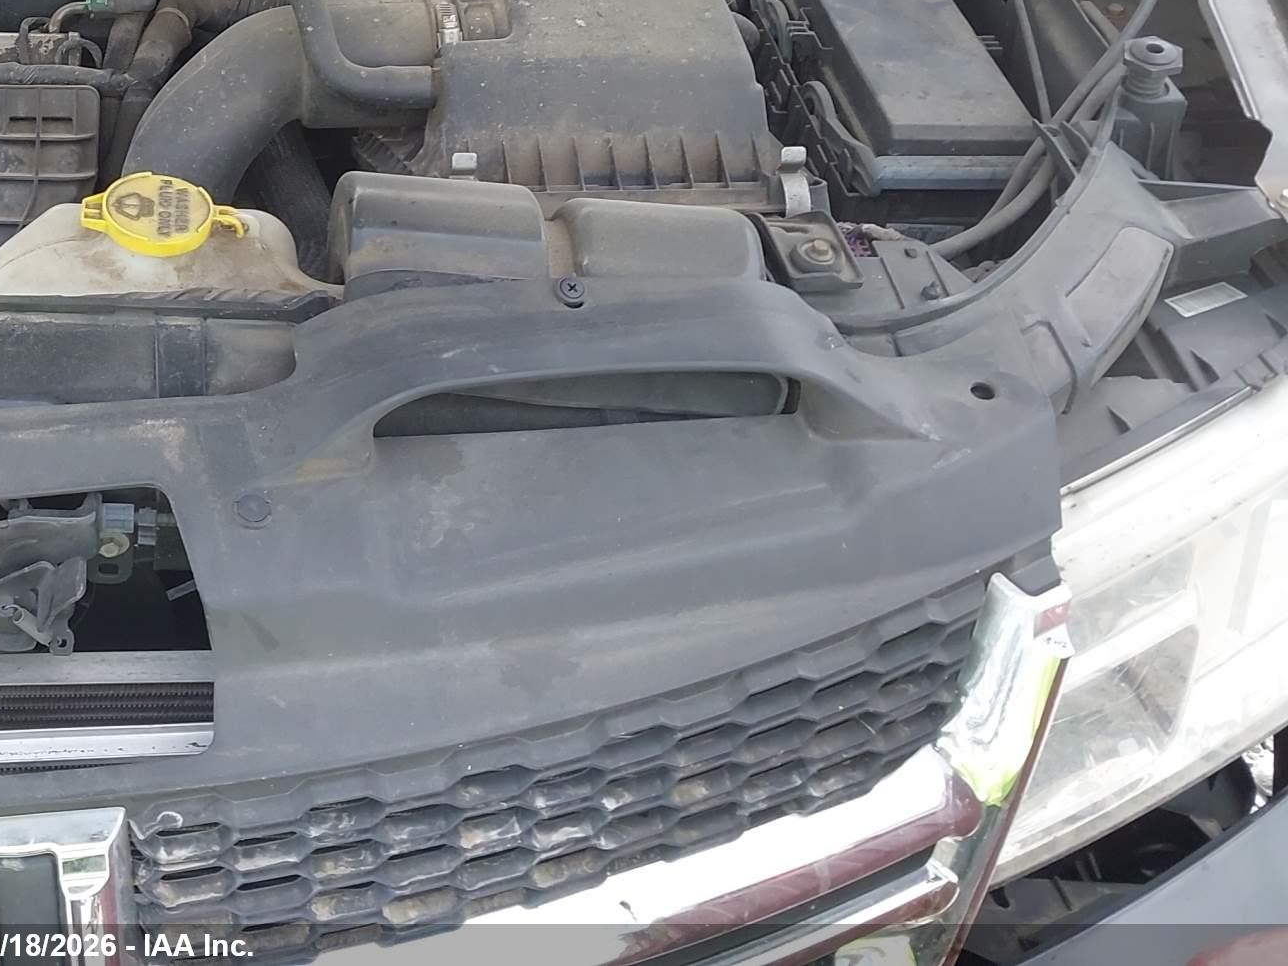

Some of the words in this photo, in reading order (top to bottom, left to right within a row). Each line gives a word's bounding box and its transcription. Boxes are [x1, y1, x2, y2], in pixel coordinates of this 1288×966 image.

[158, 179, 172, 208] FLUID
[157, 210, 171, 236] ONLY
[175, 188, 189, 233] WASHER
